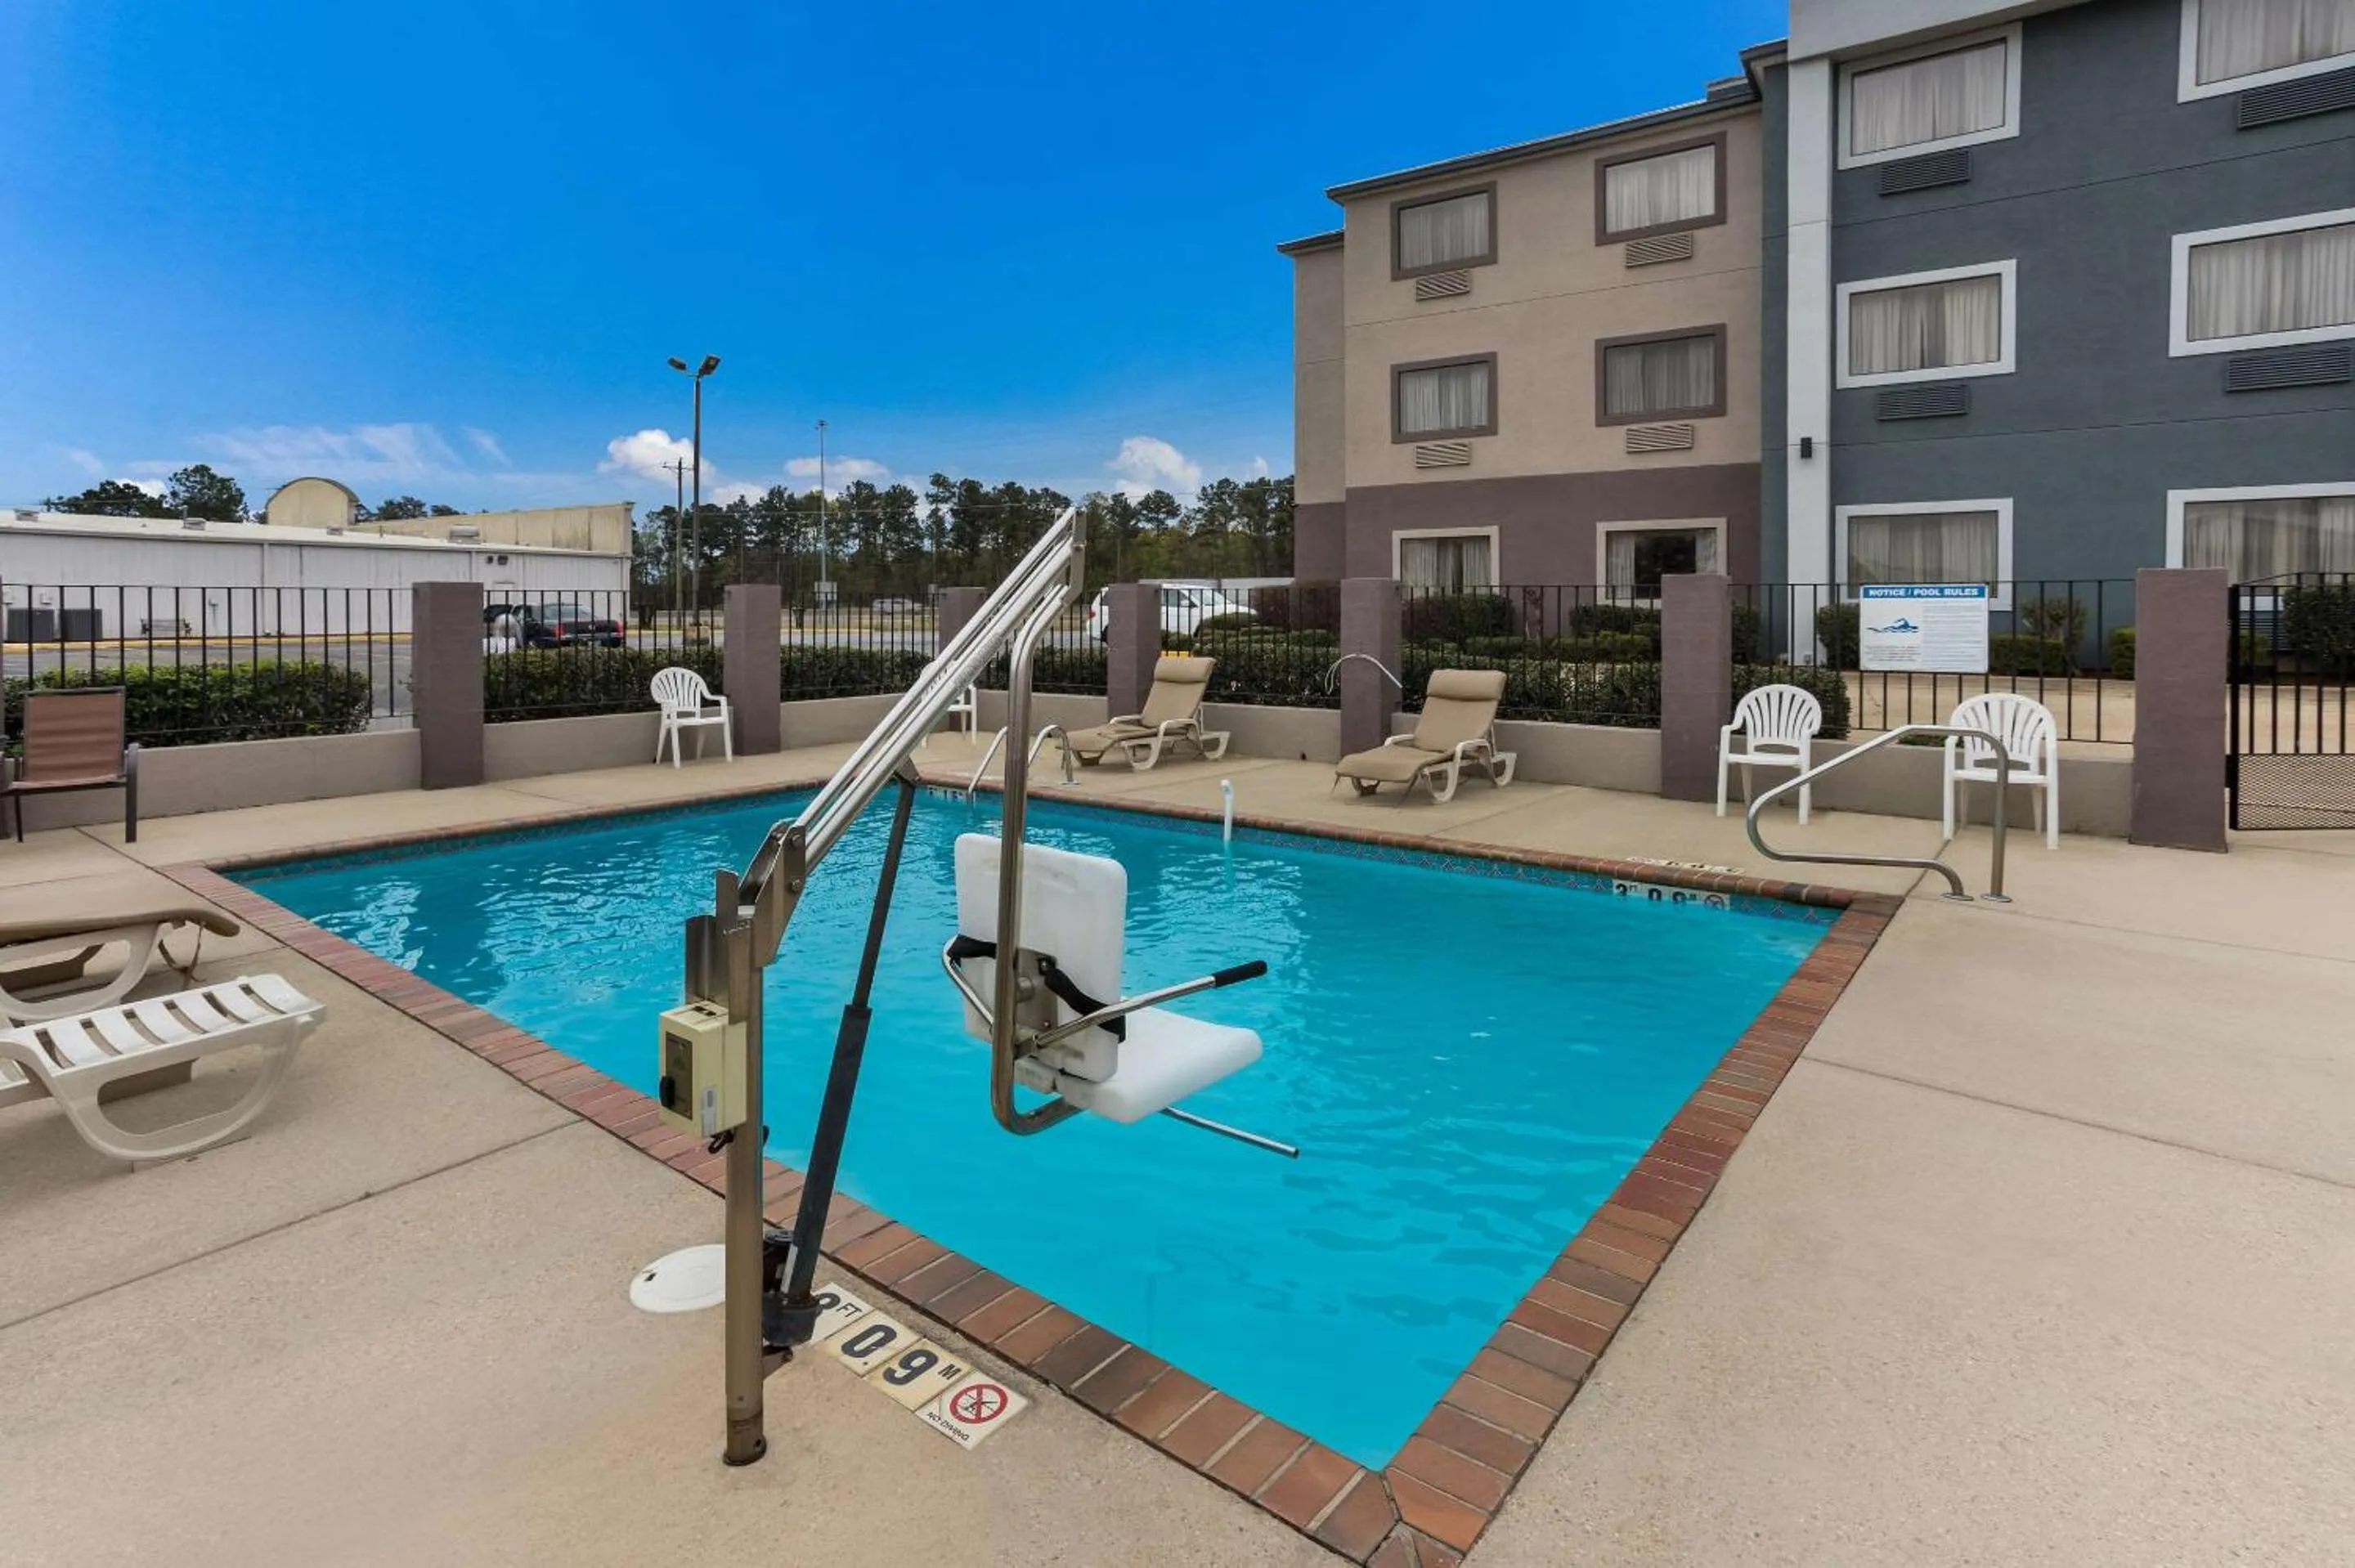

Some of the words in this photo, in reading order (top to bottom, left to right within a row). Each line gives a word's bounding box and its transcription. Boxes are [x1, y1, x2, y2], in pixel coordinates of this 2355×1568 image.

[1868, 589, 1905, 597] NOTICE
[1913, 588, 1941, 596] POOL
[1944, 588, 1980, 596] RULES
